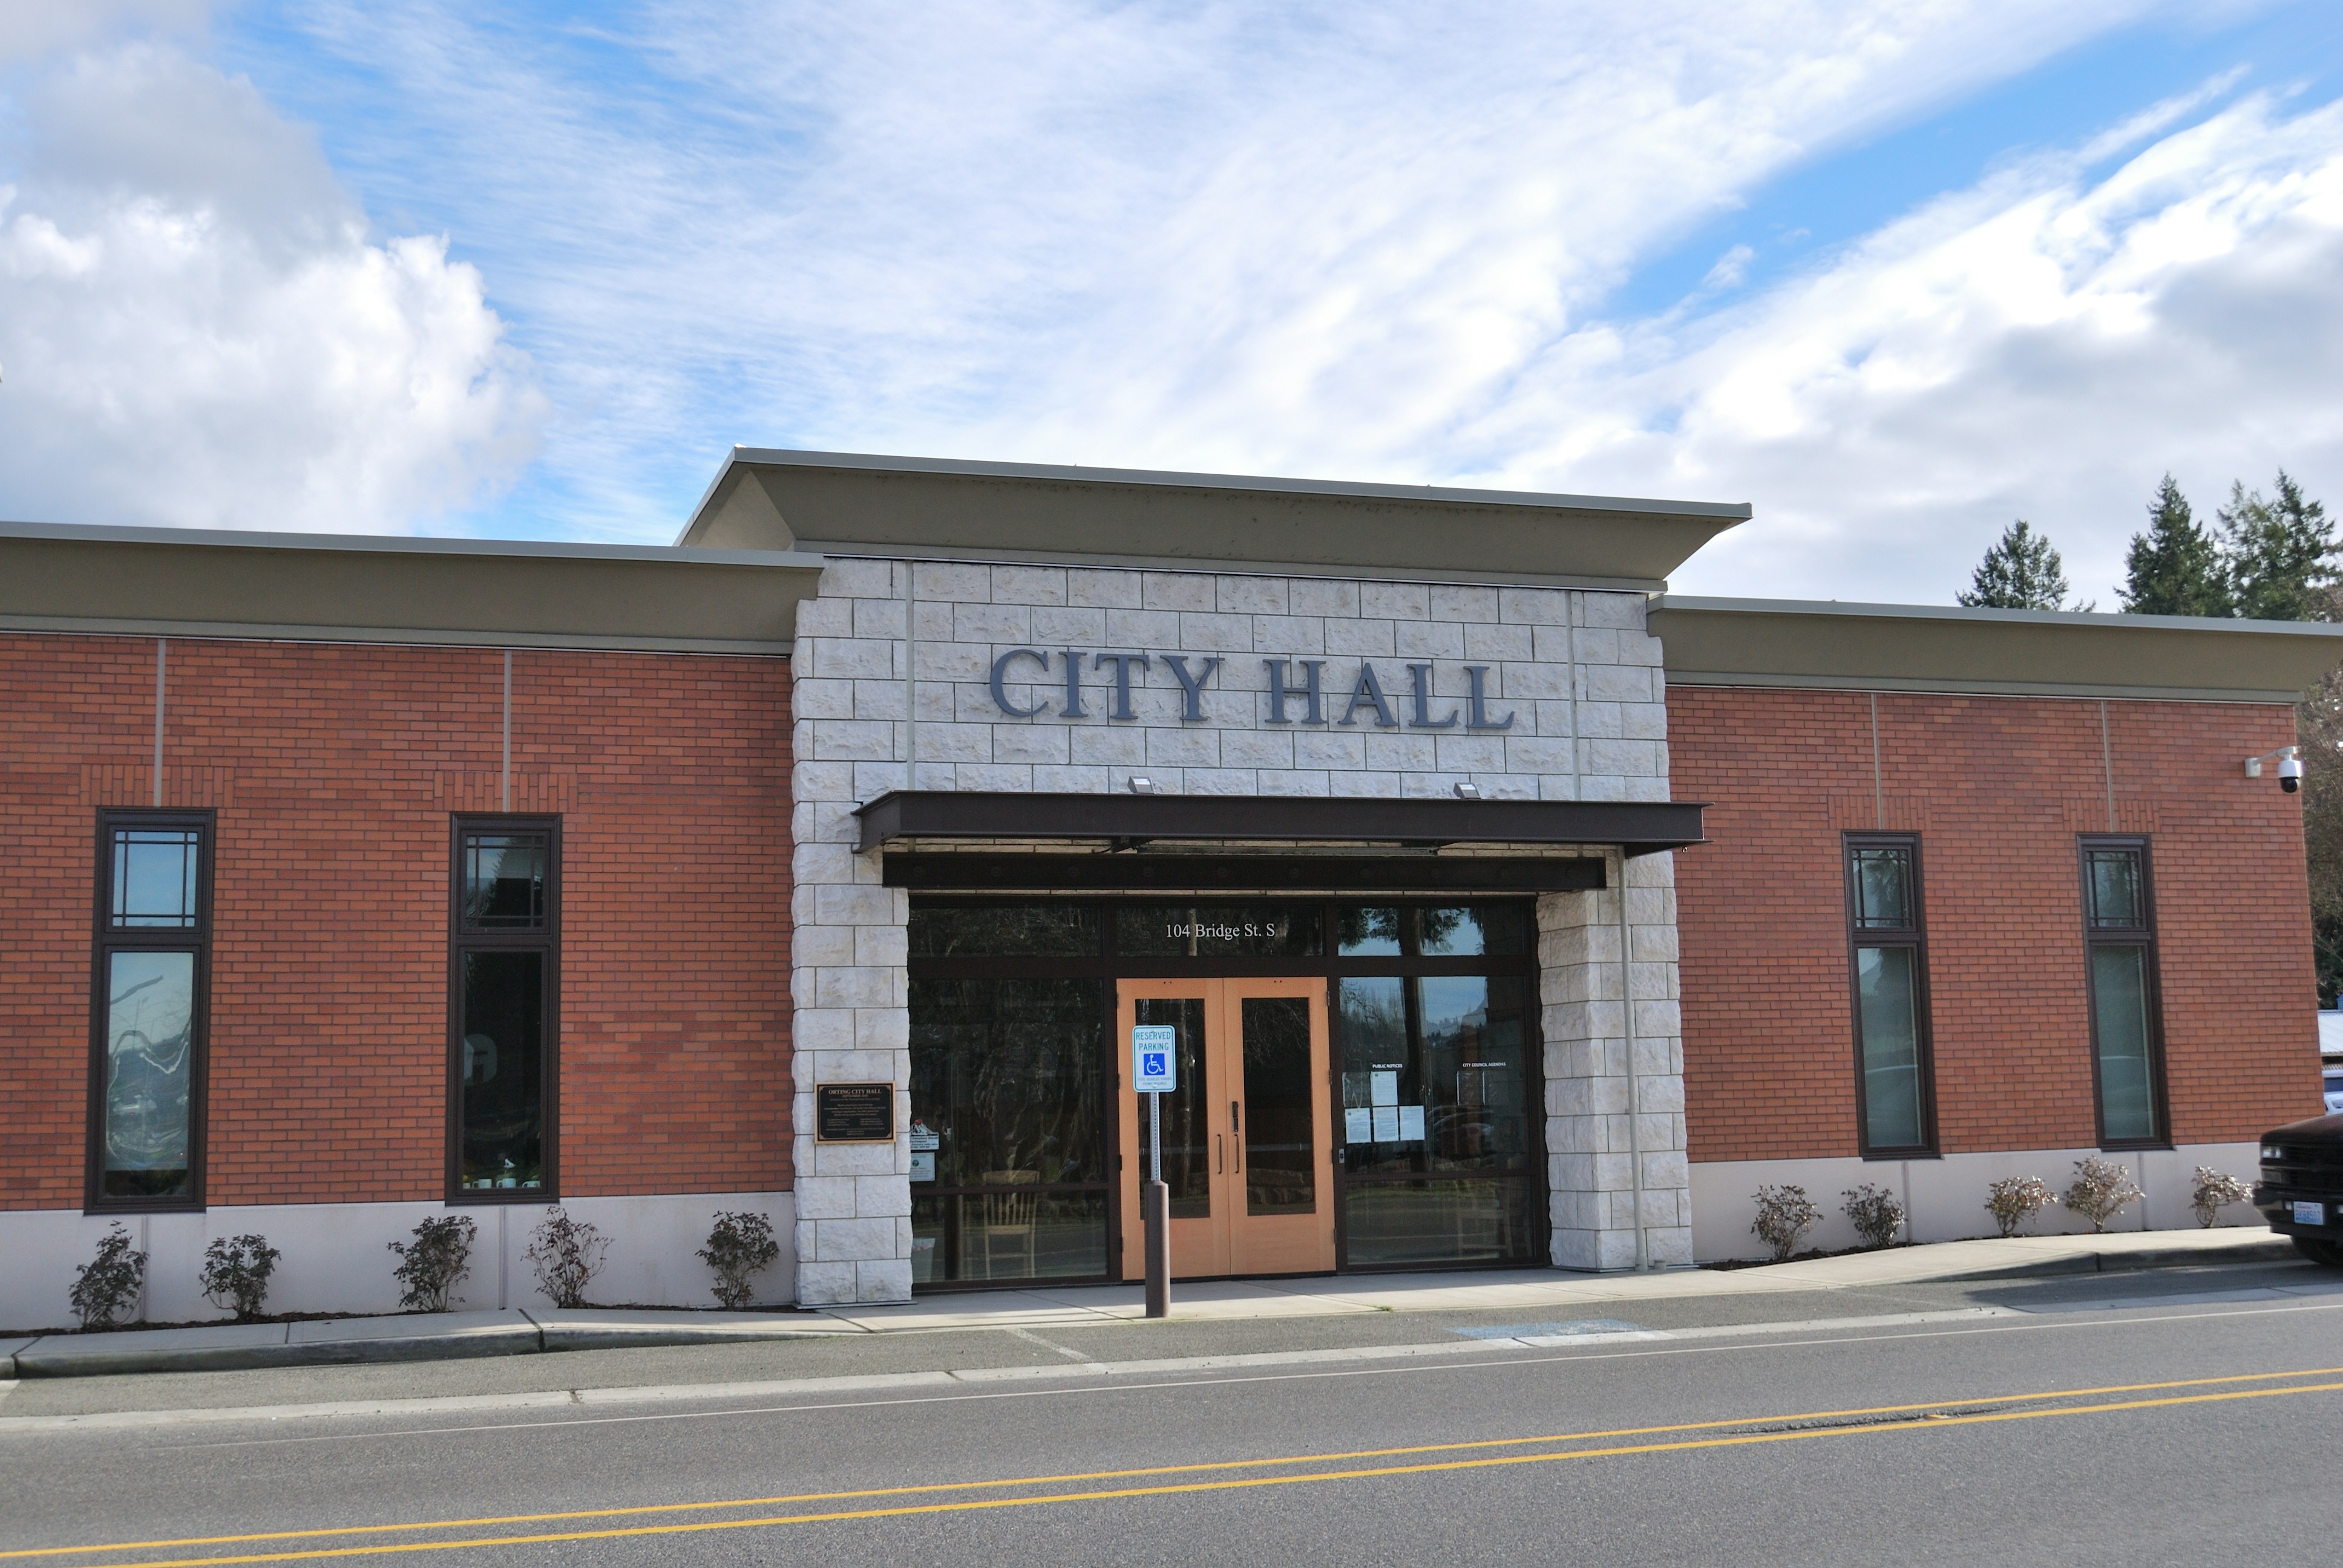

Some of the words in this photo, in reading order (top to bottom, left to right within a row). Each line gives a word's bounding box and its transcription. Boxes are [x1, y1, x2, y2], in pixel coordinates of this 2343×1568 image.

[990, 649, 1225, 721] CITY
[1262, 659, 1515, 729] HALL
[1167, 924, 1190, 938] 104
[1194, 923, 1240, 941] Bridge
[1244, 923, 1262, 936] St.
[1266, 923, 1276, 936] S
[1136, 1031, 1171, 1040] RESERVED
